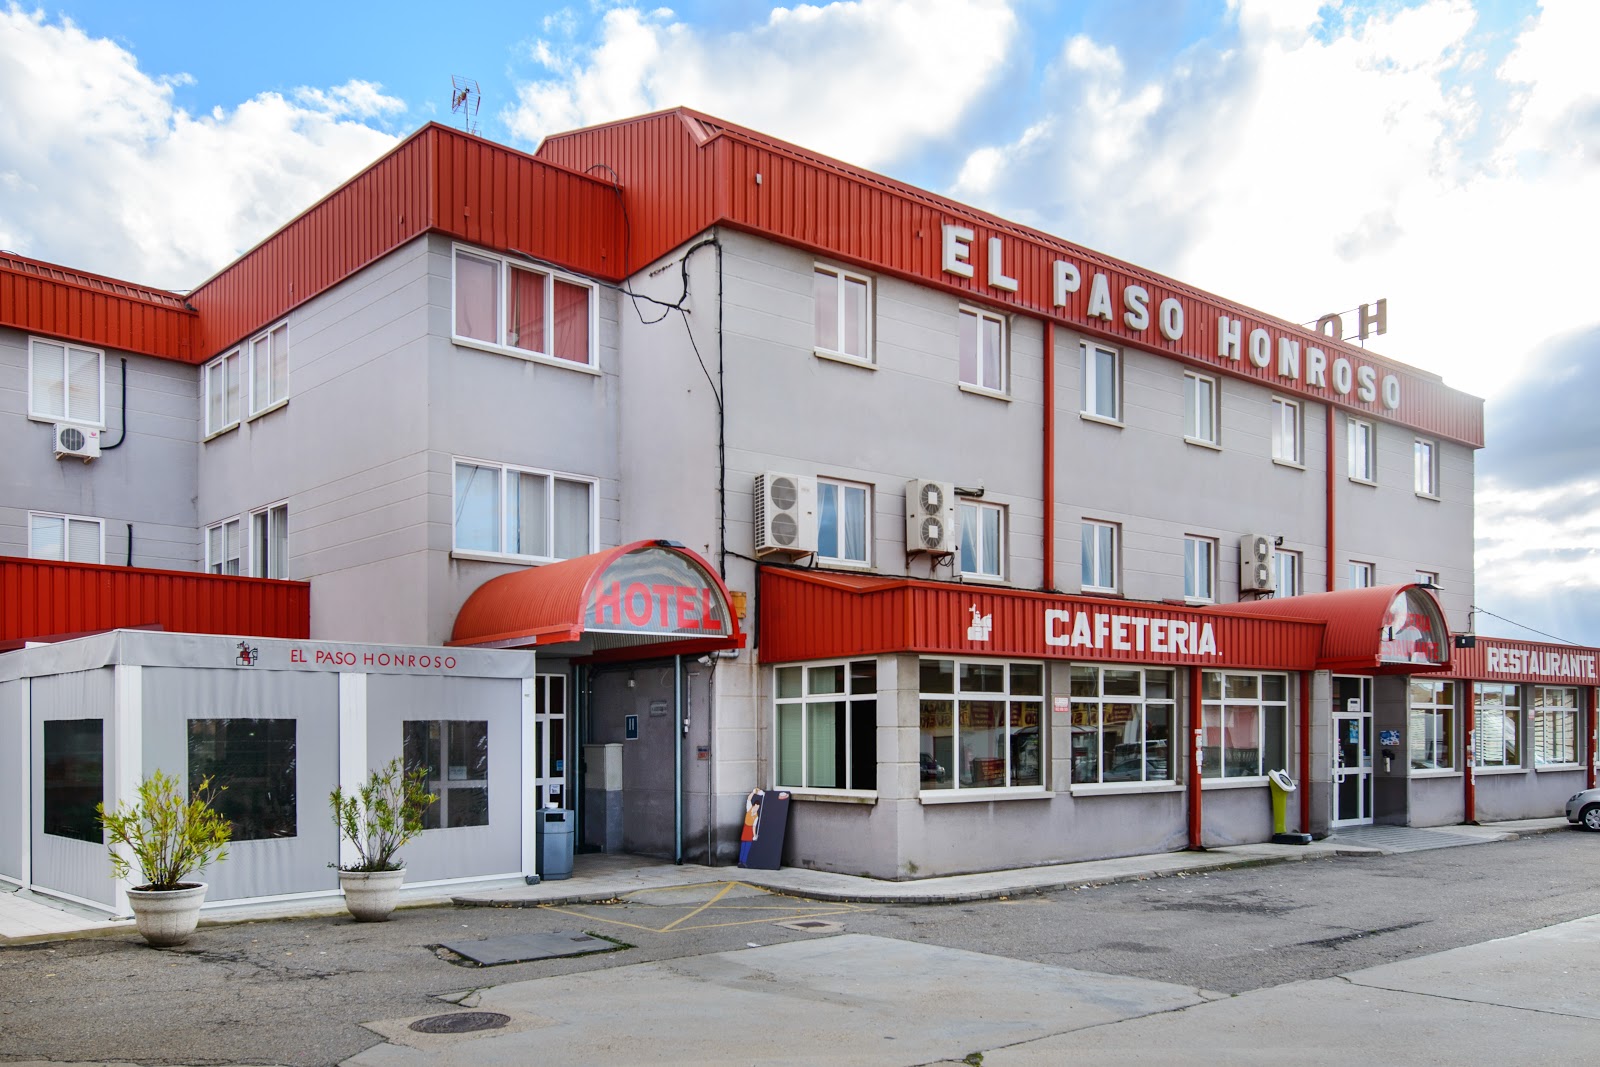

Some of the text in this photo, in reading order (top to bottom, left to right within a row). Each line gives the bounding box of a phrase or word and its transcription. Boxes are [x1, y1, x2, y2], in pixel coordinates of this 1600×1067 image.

[942, 223, 1400, 410] EL PASO HONROSO
[595, 580, 721, 630] HOTEL
[290, 649, 457, 669] EL PASO HONROSO
